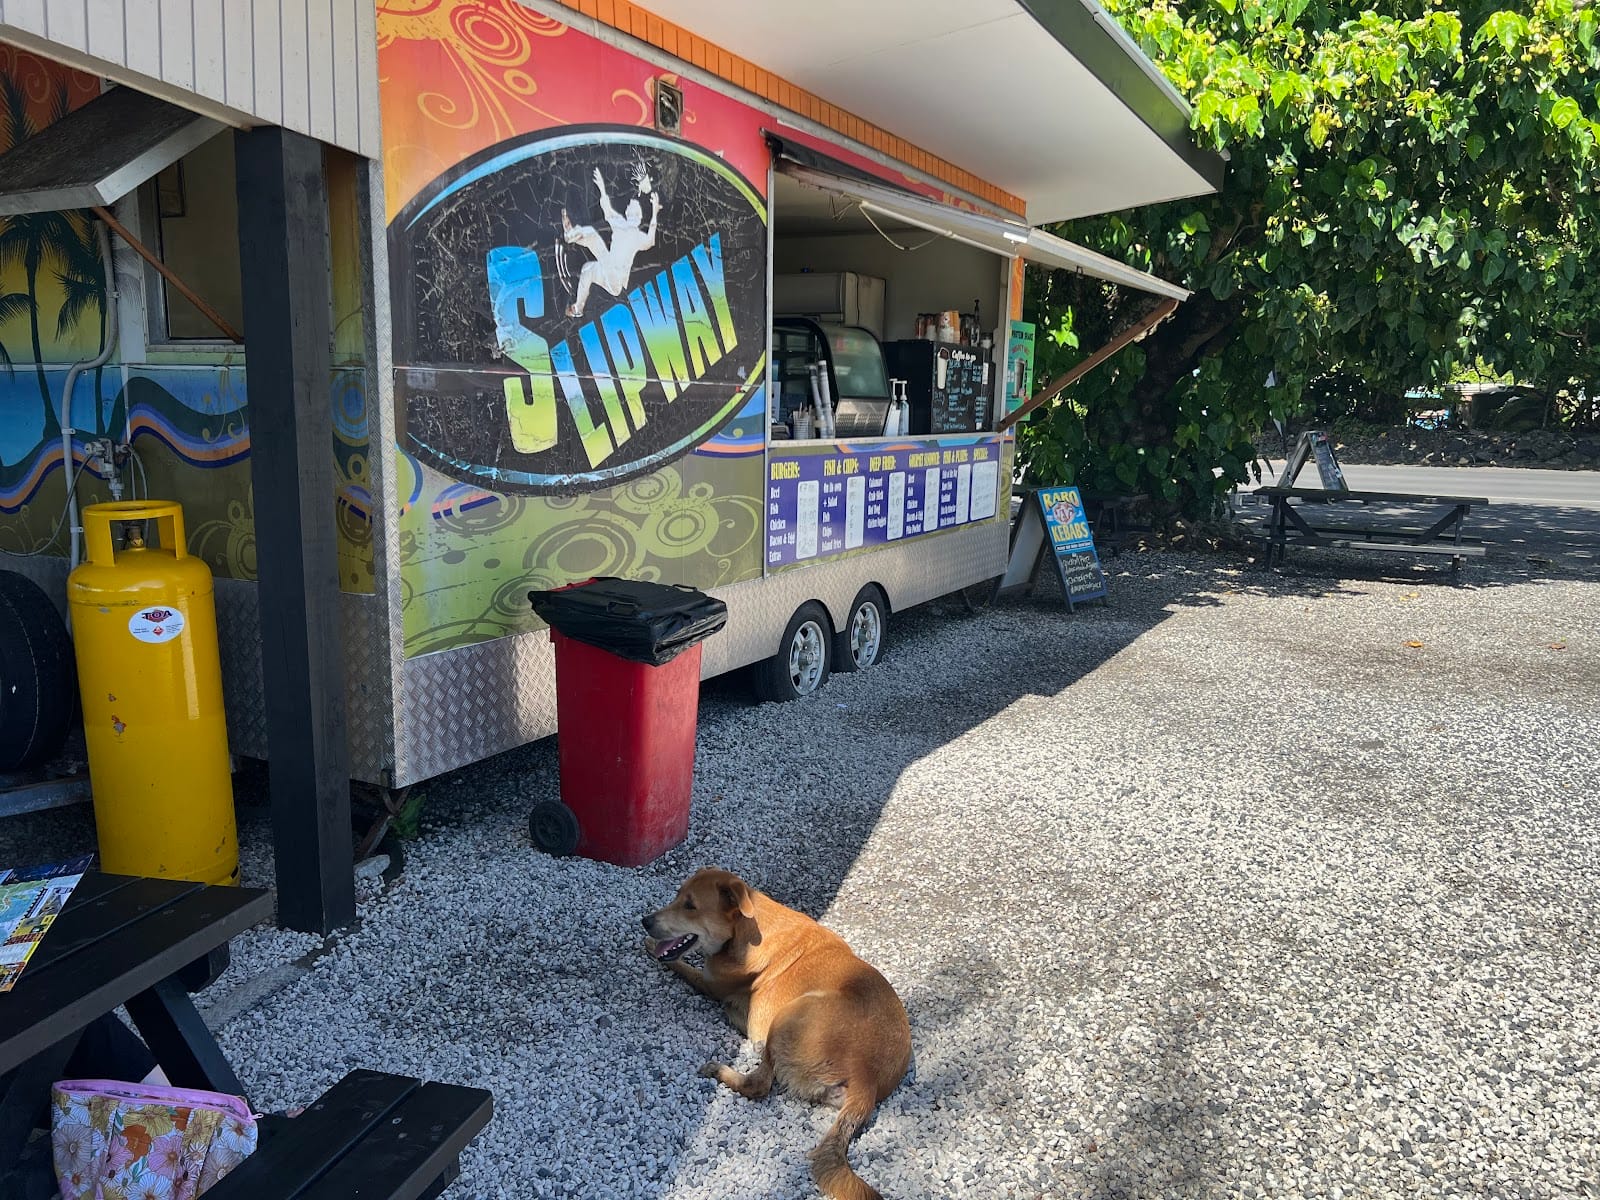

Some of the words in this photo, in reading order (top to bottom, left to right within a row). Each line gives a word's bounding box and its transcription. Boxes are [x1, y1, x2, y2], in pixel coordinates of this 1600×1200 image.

[486, 231, 738, 470] SLIPWAY
[952, 350, 965, 361] Coffee
[966, 352, 971, 360] to
[771, 462, 800, 480] BURGERS:
[824, 459, 836, 476] FISH
[836, 459, 842, 475] &
[843, 458, 858, 474] CHIPS:
[771, 486, 780, 499] Beef
[1042, 490, 1080, 512] RARO
[770, 502, 779, 515] Fish
[770, 519, 786, 531] Chicken
[1051, 522, 1088, 542] KEBABS
[770, 535, 782, 547] Bacon
[783, 533, 787, 544] &
[769, 551, 781, 562] Extras
[141, 610, 172, 620] TOA
